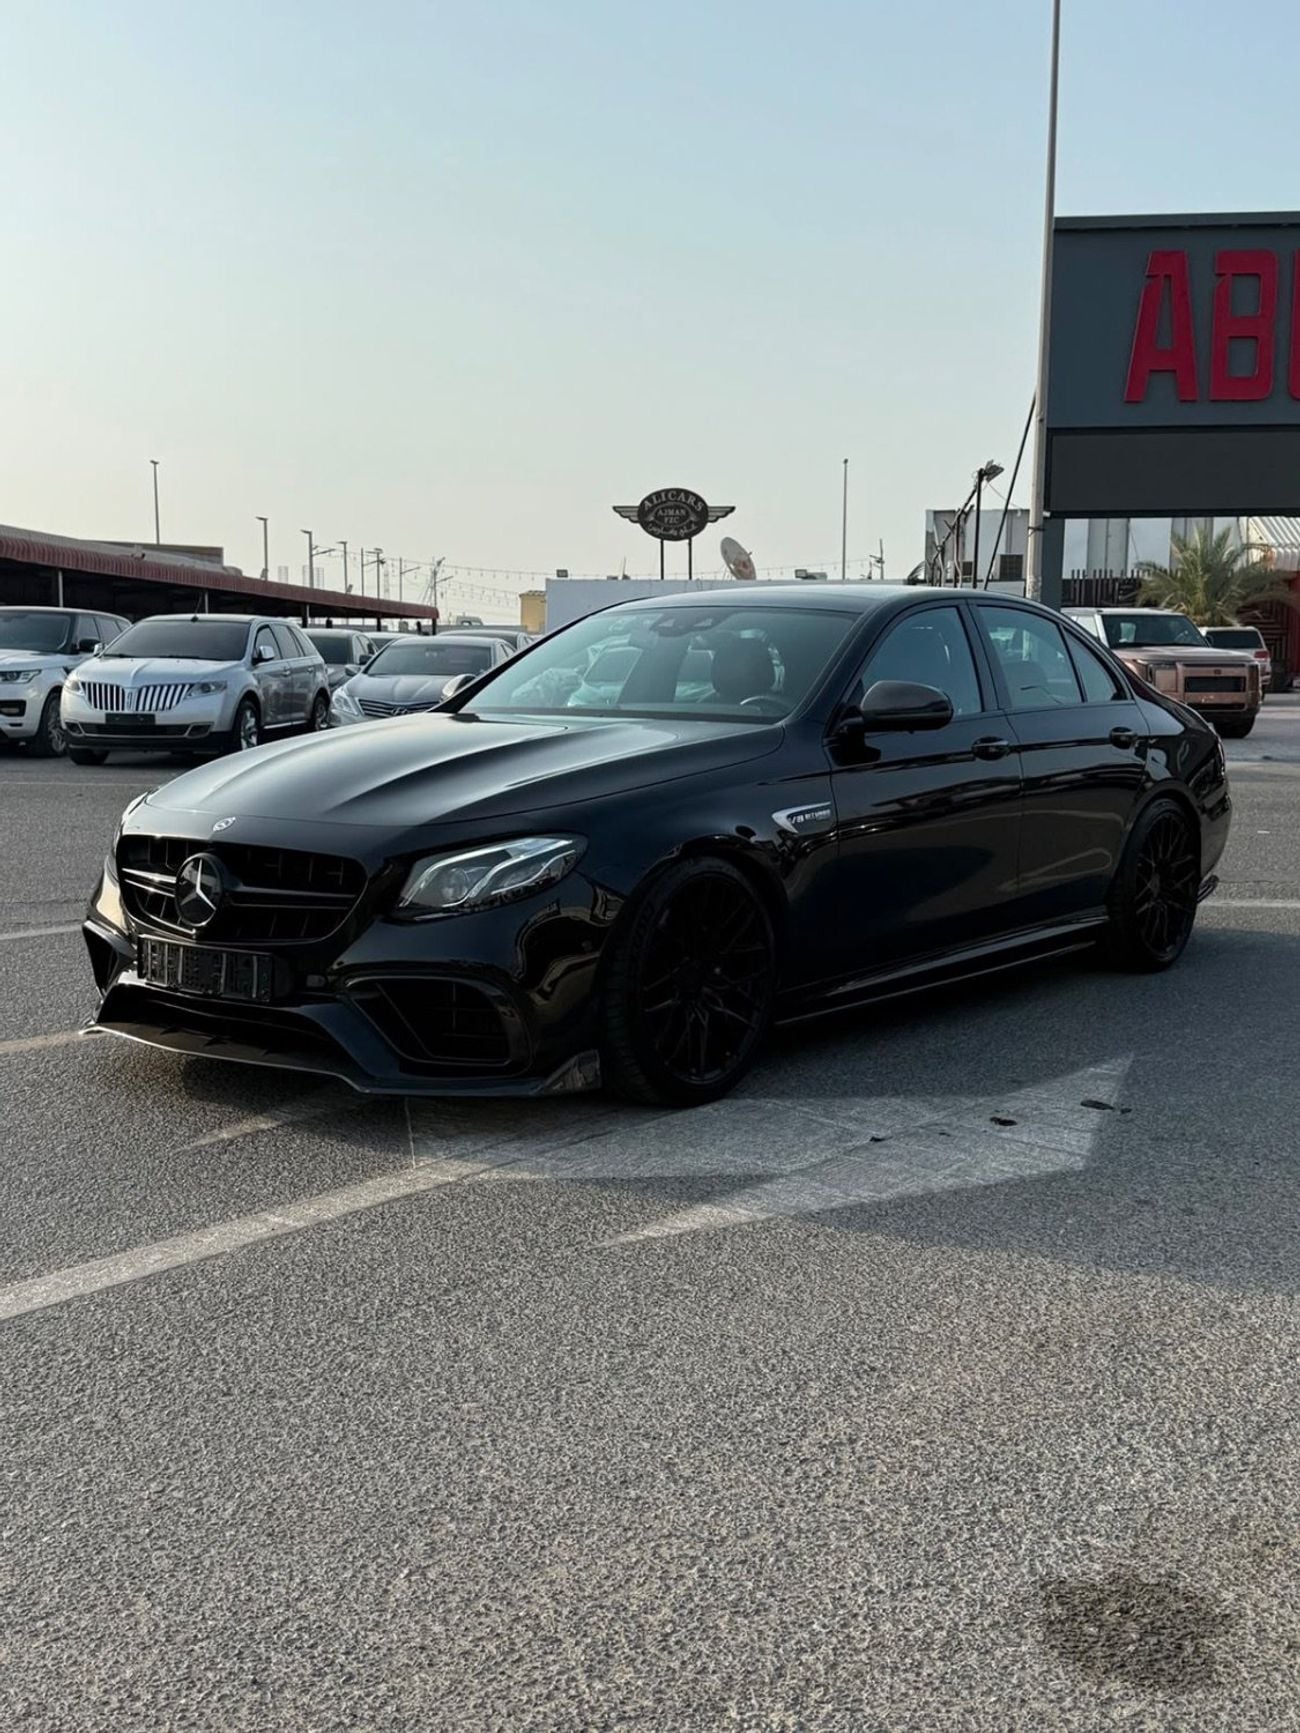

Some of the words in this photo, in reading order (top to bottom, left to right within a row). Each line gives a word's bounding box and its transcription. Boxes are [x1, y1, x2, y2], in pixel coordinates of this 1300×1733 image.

[1124, 249, 1300, 403] AB
[644, 491, 703, 511] ALICARS
[658, 508, 686, 516] AJMAN
